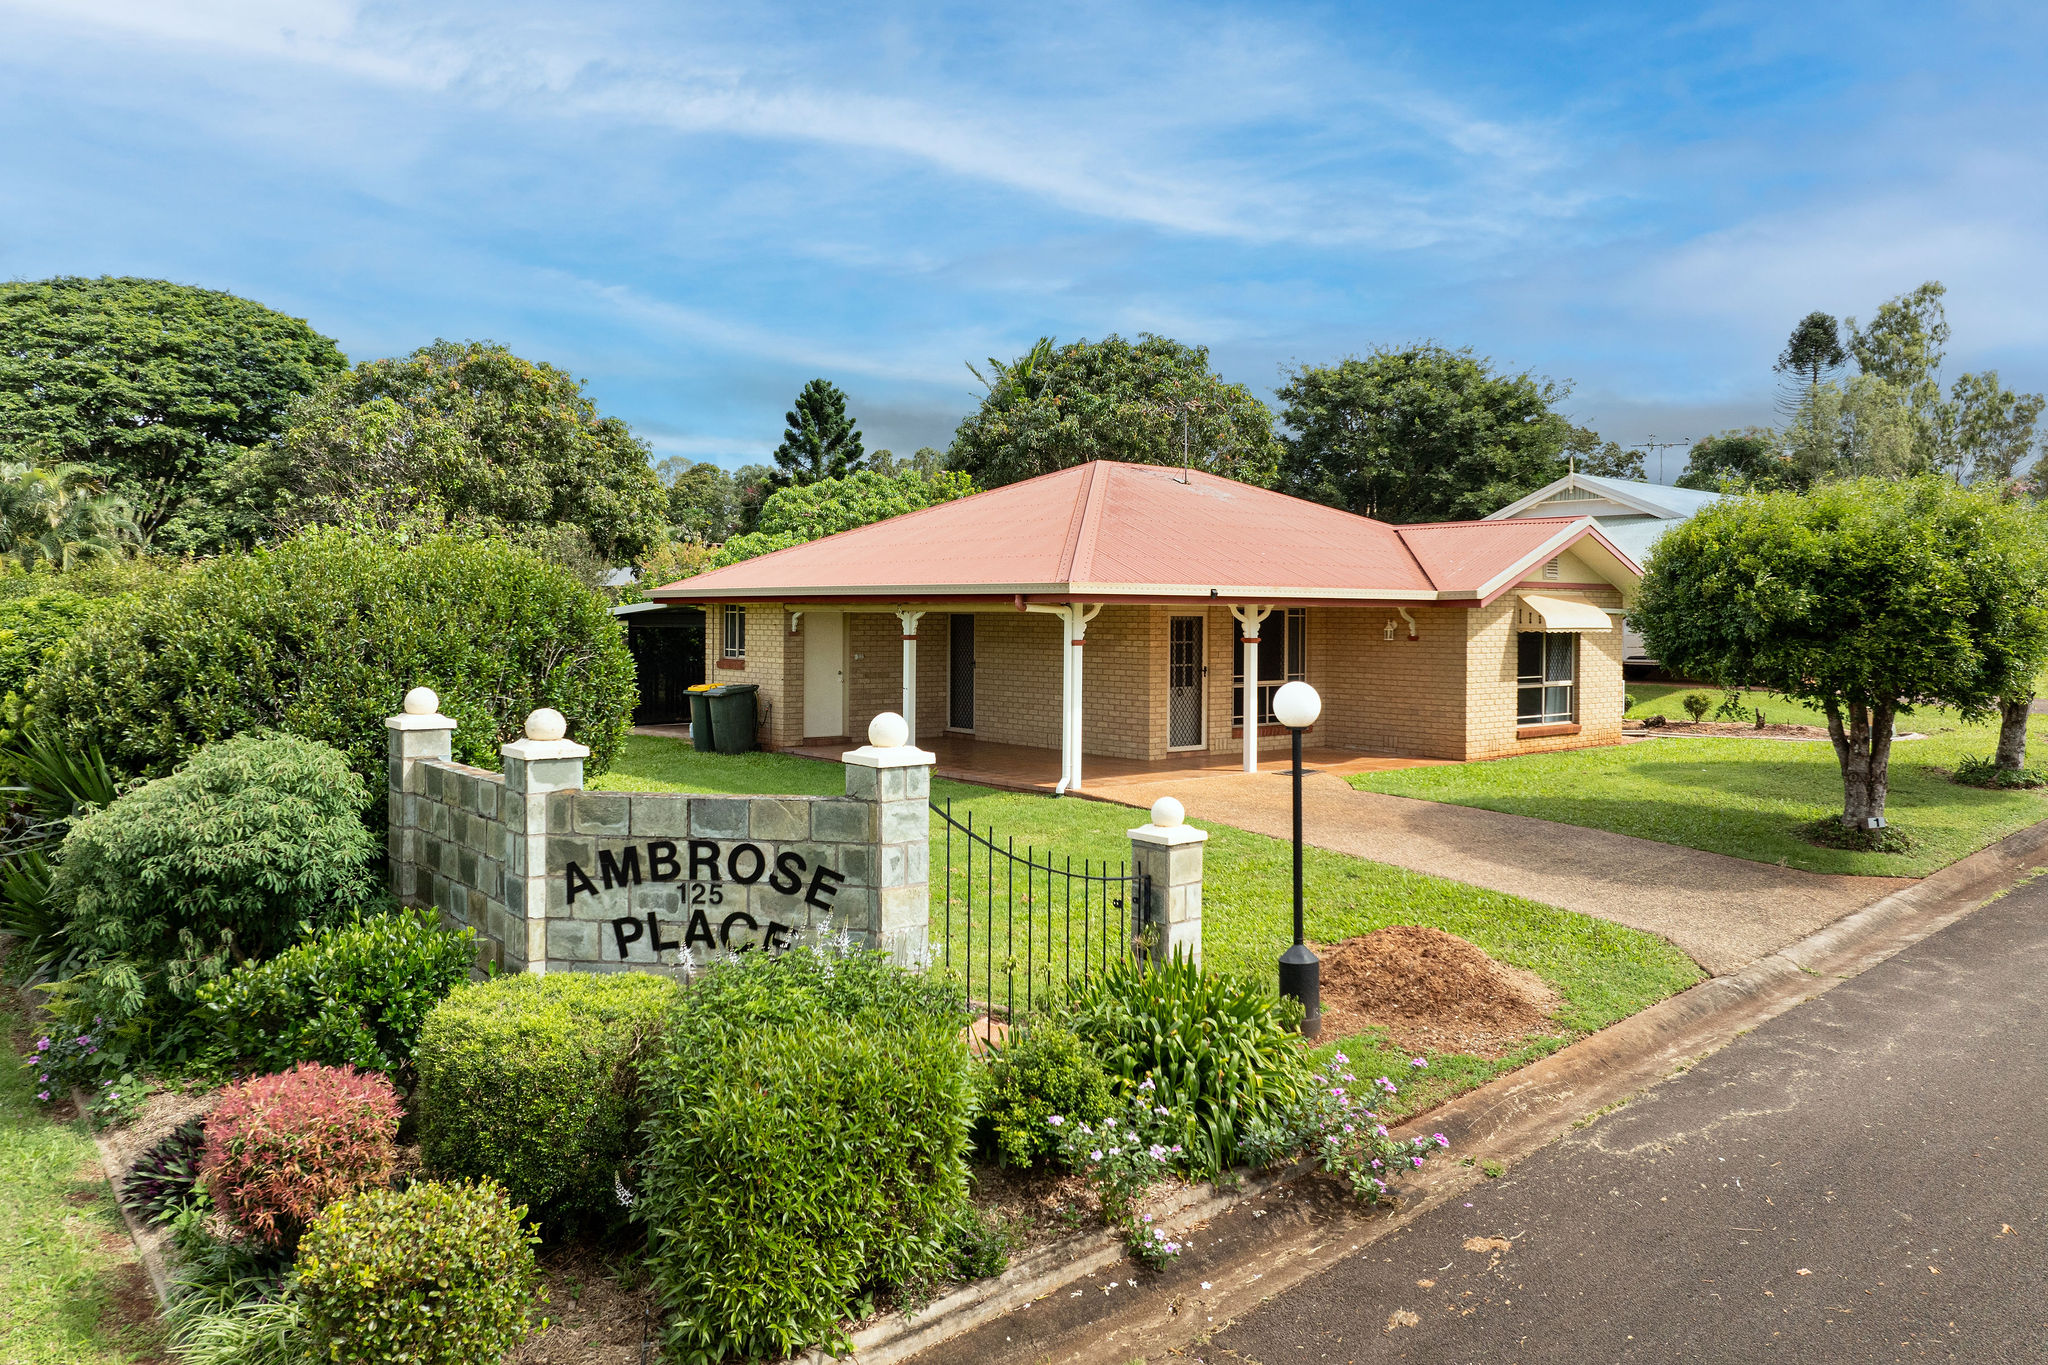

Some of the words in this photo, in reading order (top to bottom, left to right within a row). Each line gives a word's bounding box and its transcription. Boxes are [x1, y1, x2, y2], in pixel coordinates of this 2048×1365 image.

[1873, 818, 1880, 827] 1
[566, 840, 845, 912] AMBROSE
[676, 883, 724, 905] 125
